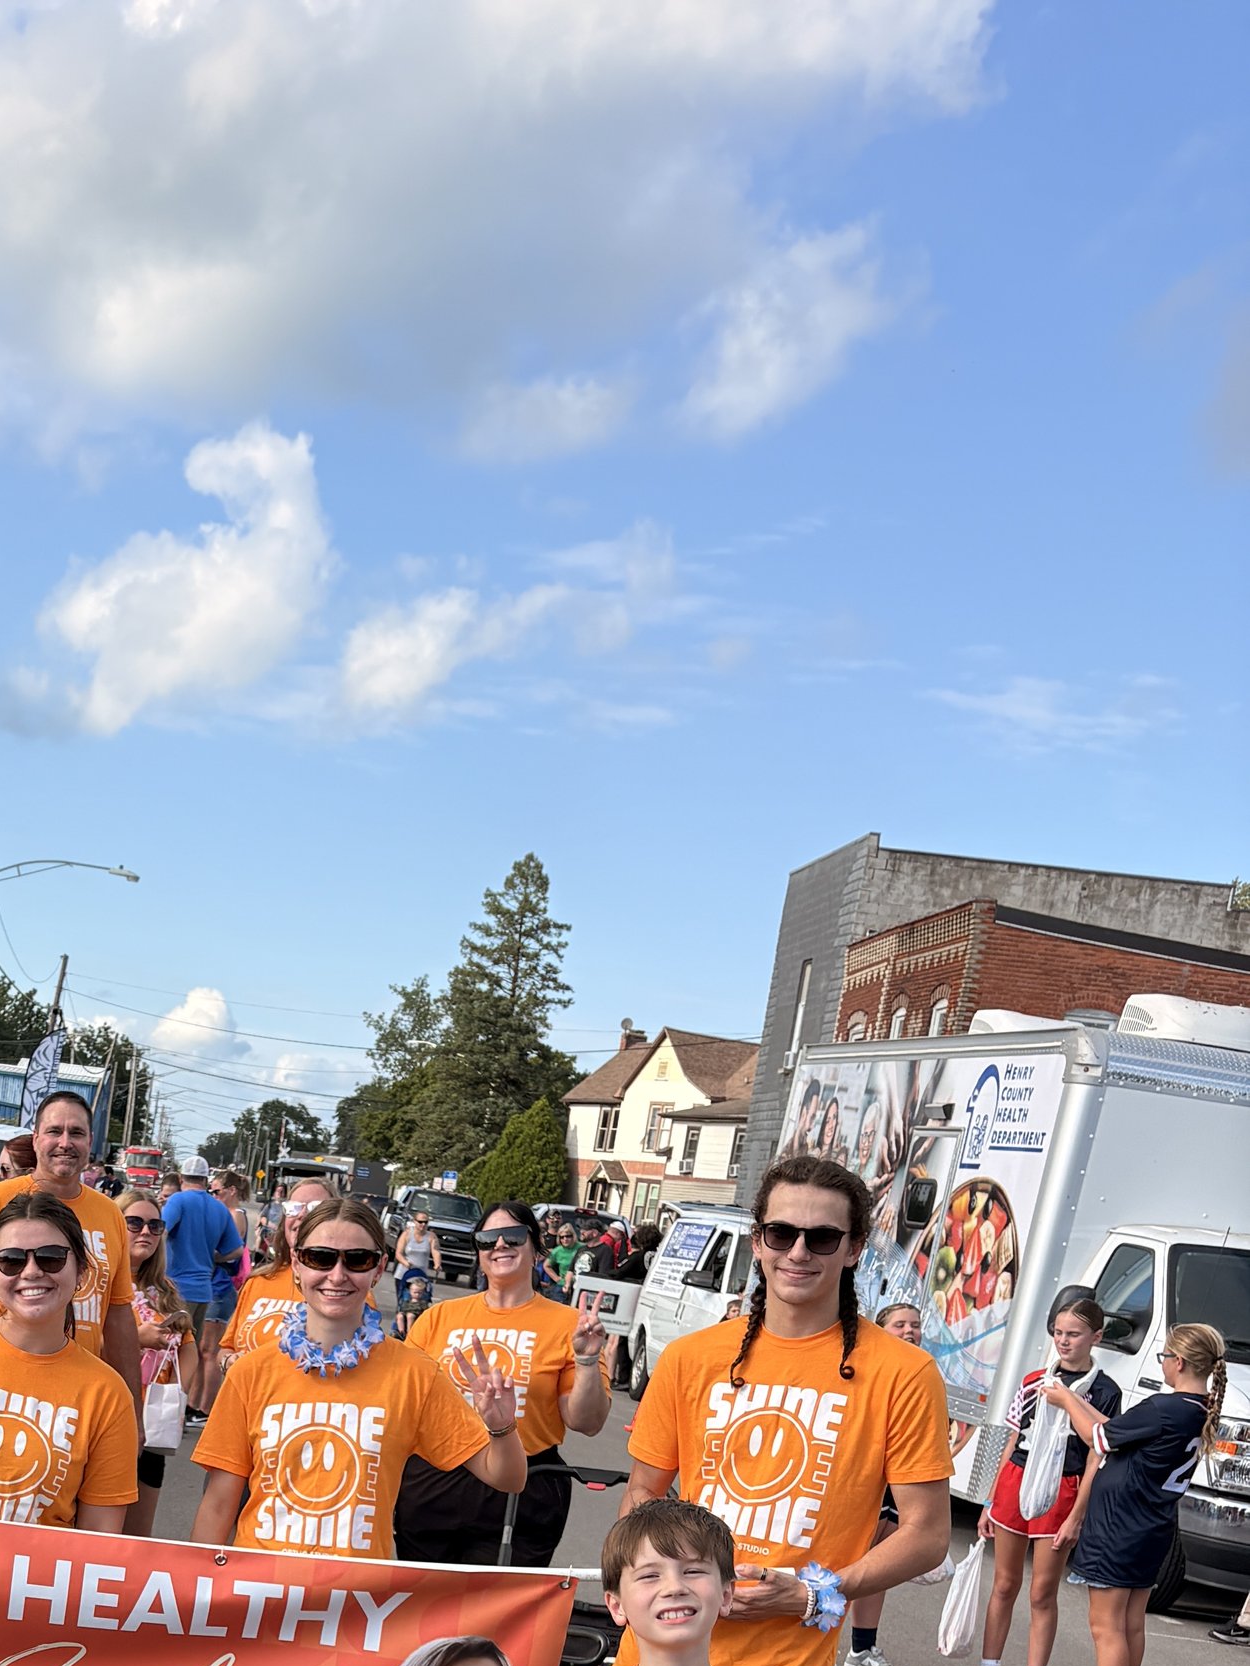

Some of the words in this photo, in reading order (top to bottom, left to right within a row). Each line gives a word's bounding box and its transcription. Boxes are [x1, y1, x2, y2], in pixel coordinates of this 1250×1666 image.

[1004, 1064, 1035, 1080] HENRY
[1001, 1087, 1034, 1101] COUNTY
[996, 1108, 1029, 1122] HEALTH
[991, 1131, 1047, 1145] DEPARTMENT
[706, 1382, 849, 1443] SHINE
[260, 1402, 386, 1453] SHINE
[254, 1496, 377, 1550] SHINE
[737, 1542, 770, 1556] STUDIO
[7, 1554, 414, 1653] HEALTHY
